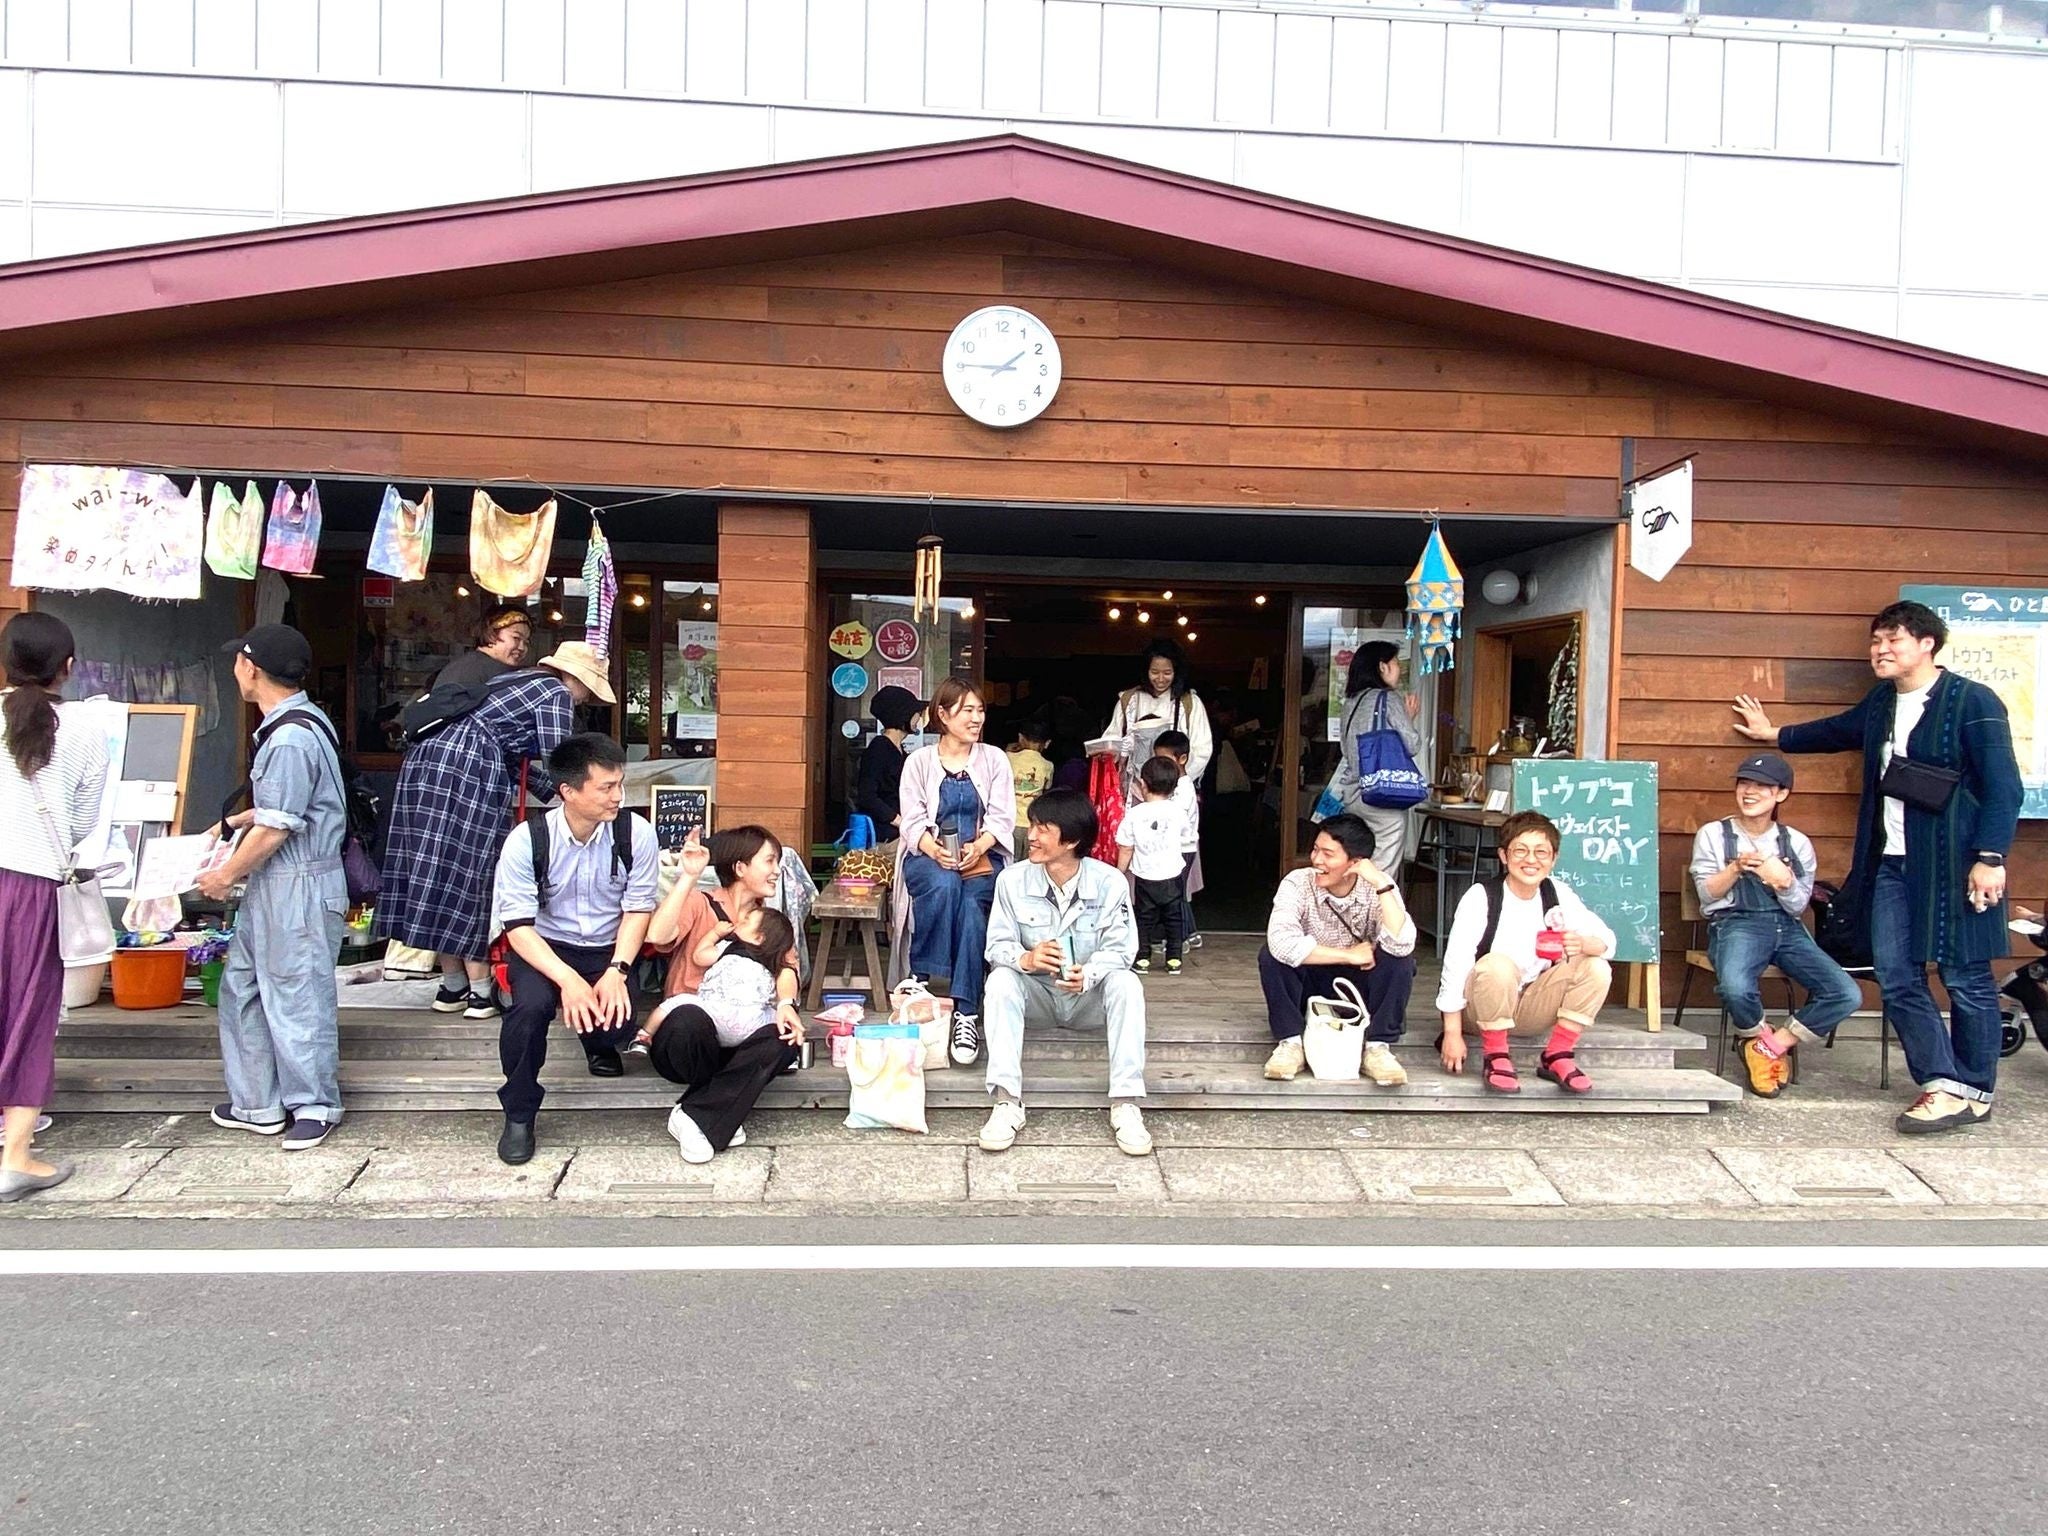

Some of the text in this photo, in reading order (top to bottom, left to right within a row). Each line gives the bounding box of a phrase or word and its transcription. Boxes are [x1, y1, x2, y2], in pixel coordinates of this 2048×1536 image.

[976, 327, 988, 338] 11
[995, 321, 1010, 332] 12
[1020, 328, 1026, 339] 1
[961, 341, 975, 353] 10
[1034, 343, 1043, 355] 2
[956, 362, 965, 373] 9
[1039, 364, 1048, 376] 3
[963, 382, 972, 394] 8
[1033, 385, 1042, 397] 4
[978, 398, 986, 409] 7
[1018, 400, 1027, 411] 5
[997, 404, 1006, 416] 6
[1531, 776, 1633, 807] トウブコ
[1582, 837, 1649, 865] DAY
